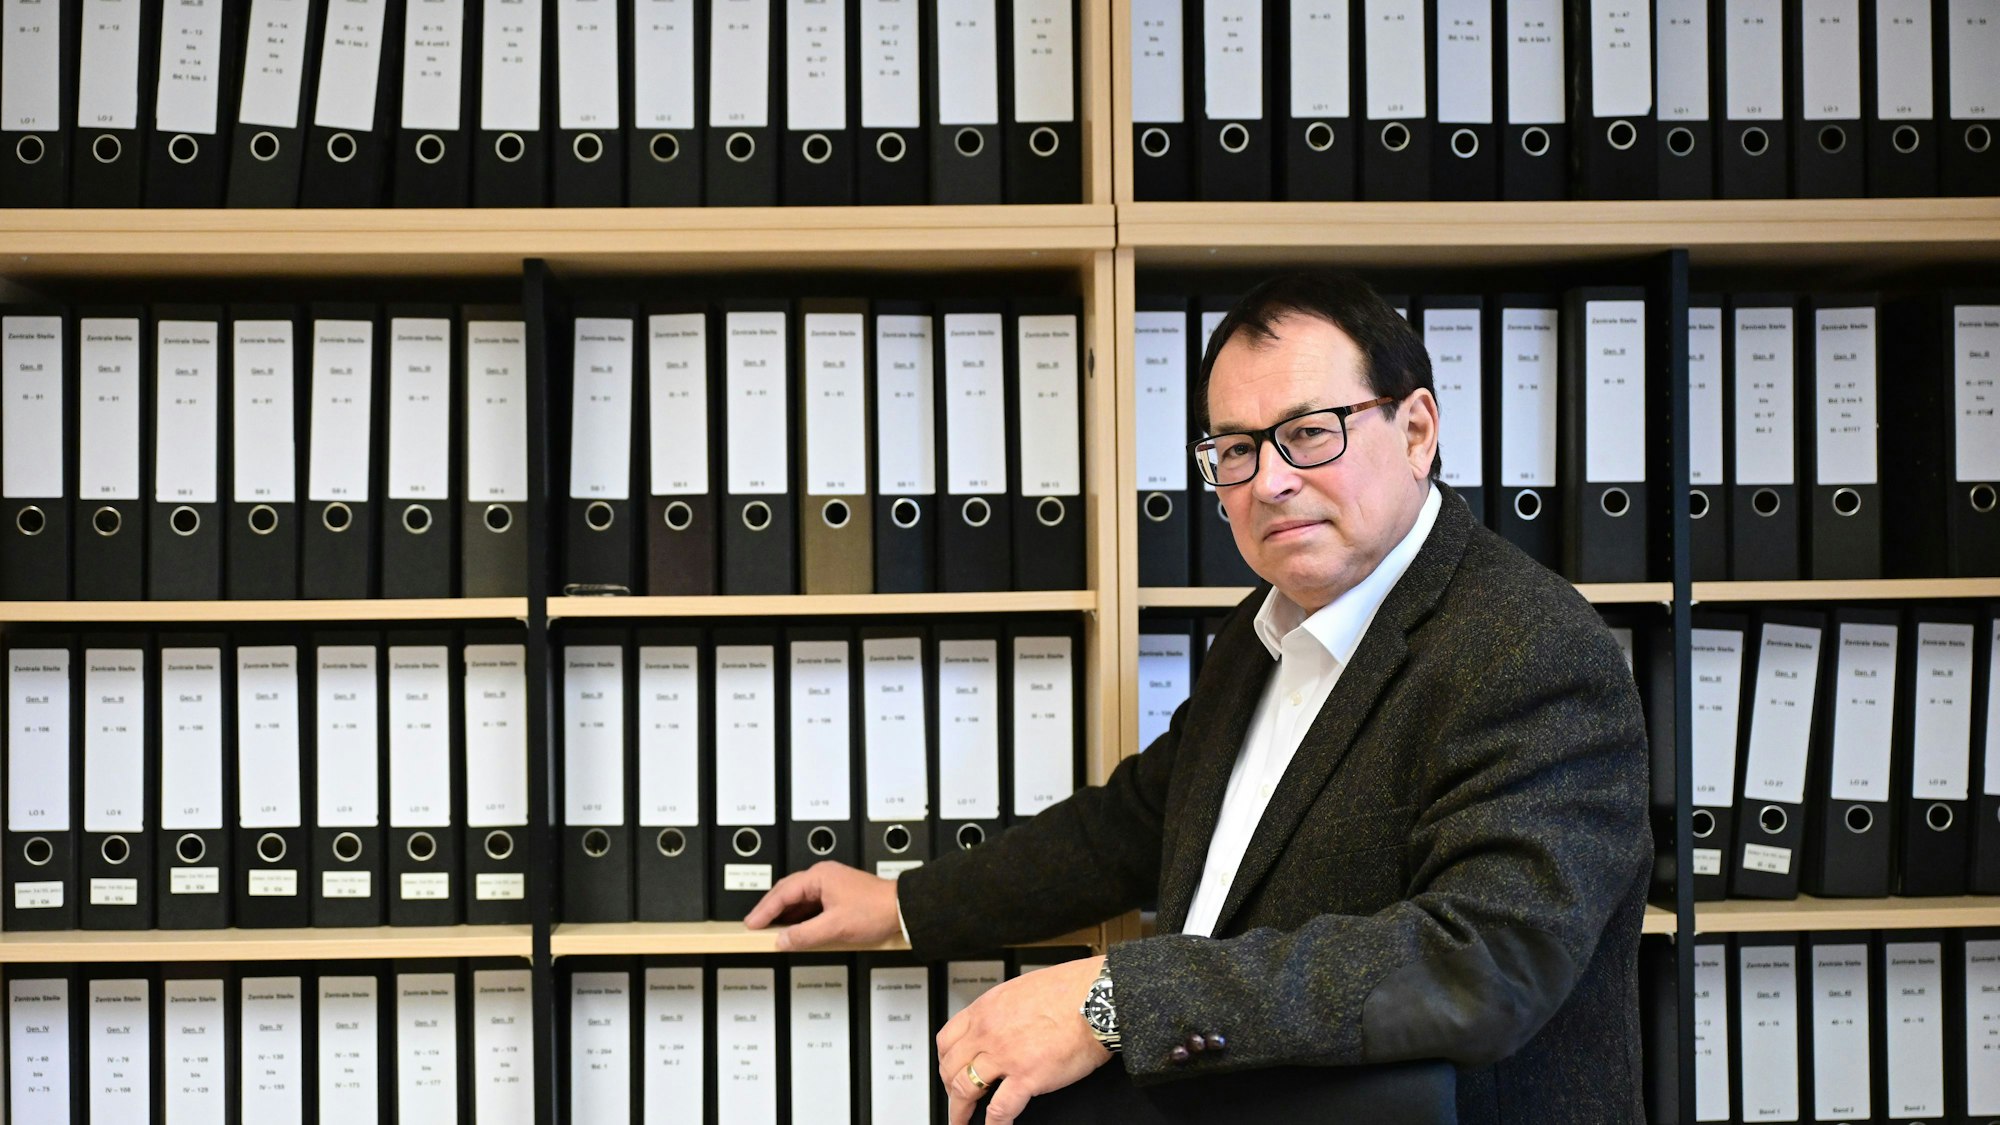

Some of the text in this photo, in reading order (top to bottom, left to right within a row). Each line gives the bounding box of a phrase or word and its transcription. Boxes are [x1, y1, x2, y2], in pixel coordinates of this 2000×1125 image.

[1592, 317, 1618, 325] Zentrale
[1821, 323, 1848, 332] Zentrale
[8, 332, 55, 340] Zentrale Stelle
[732, 328, 777, 336] Zentrale Stelle
[1025, 331, 1050, 339] Zentrale
[87, 334, 132, 342] Zentrale Stelle
[164, 337, 210, 345] Zentrale Stelle
[267, 336, 285, 344] Stelle
[398, 334, 443, 342] Zentrale Stelle
[20, 363, 35, 371] Gen.
[98, 365, 113, 373] Gen.
[1766, 638, 1812, 650] Zentrale Stelle
[1844, 638, 1890, 648] Zentrale Stelle
[1922, 638, 1965, 647] Zentrale Stelle
[1717, 645, 1735, 653] Stelle
[14, 665, 40, 673] Zentrale
[91, 664, 116, 672] Zentrale
[196, 663, 213, 671] Stelle
[244, 661, 289, 670] Zentrale Stelle
[569, 661, 595, 669] Zentrale
[1775, 670, 1790, 678] Gen.
[1855, 669, 1869, 677] Gen.
[26, 696, 41, 704] Gen.
[1746, 961, 1790, 969] Zentrale Stelle
[1818, 959, 1861, 968] Zentrale Stelle
[1892, 957, 1935, 966] Zentrale Stelle
[577, 987, 622, 995] Zentrale Stelle
[14, 994, 61, 1003] Zentrale Stelle
[124, 995, 141, 1003] Stelle
[171, 995, 216, 1004] Zentrale Stelle
[248, 993, 274, 1001] Zentrale
